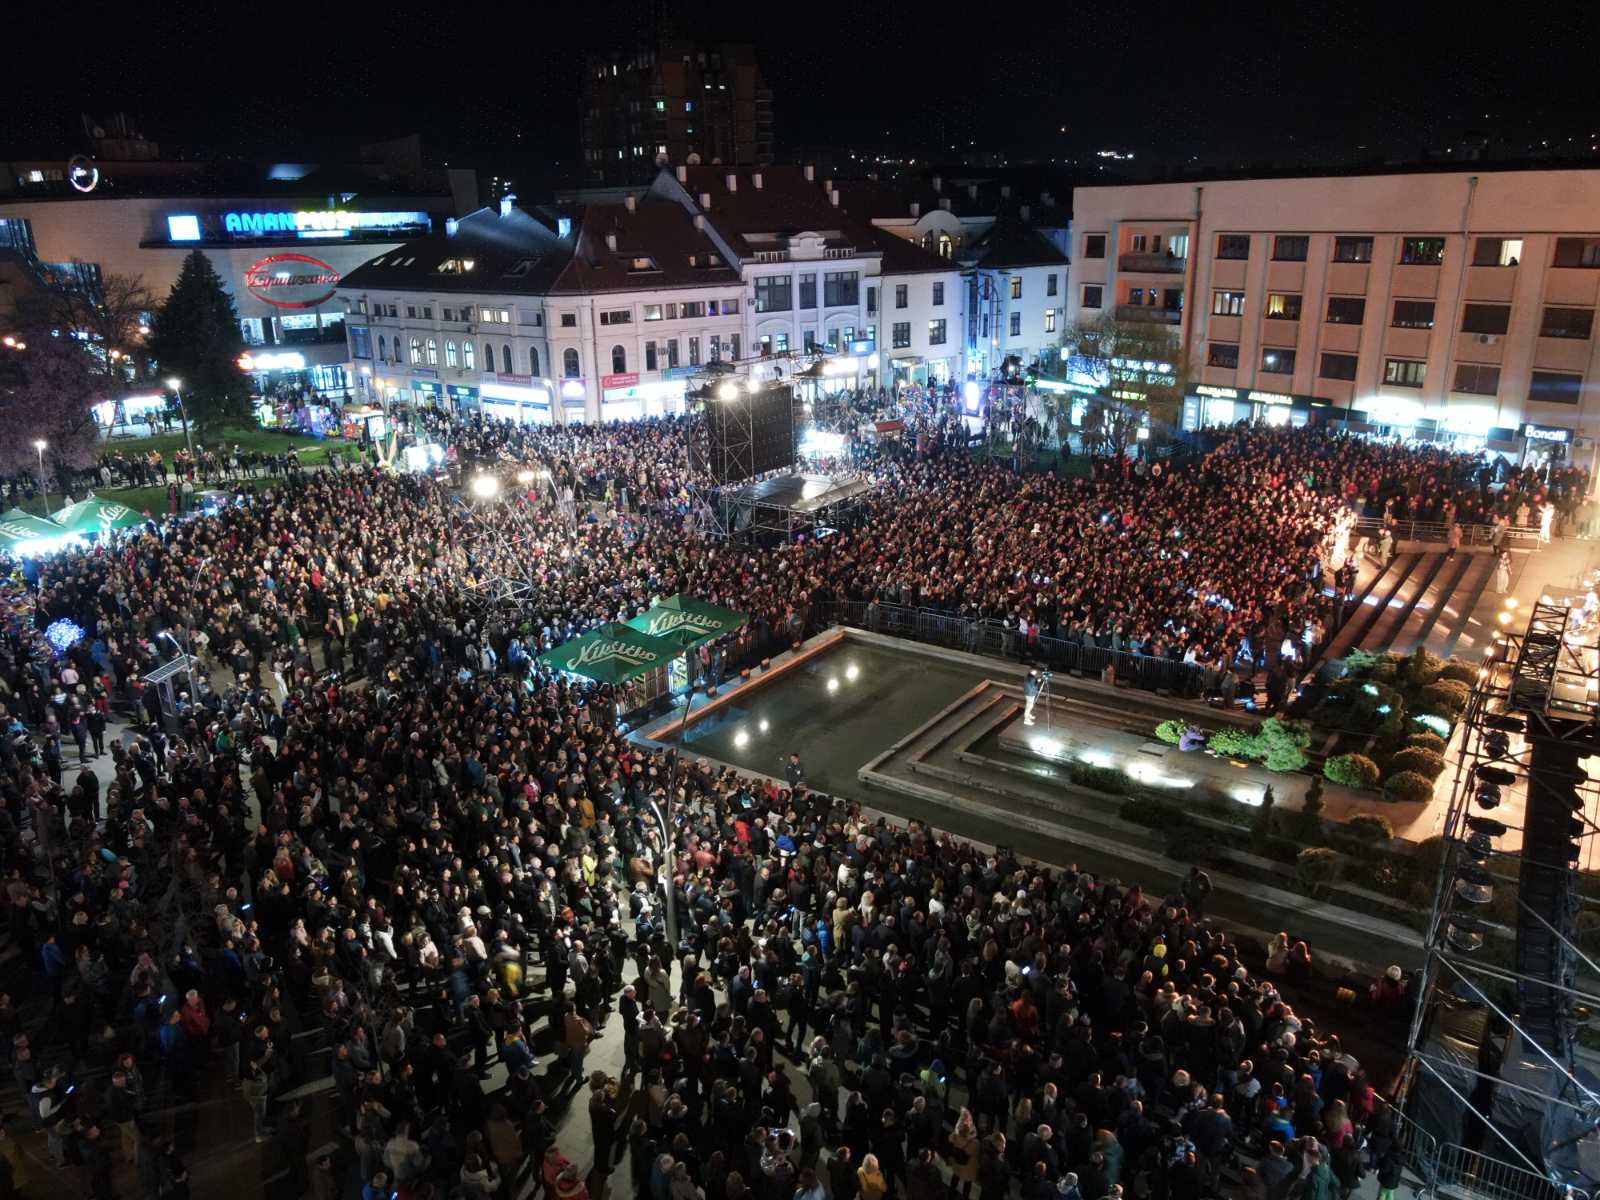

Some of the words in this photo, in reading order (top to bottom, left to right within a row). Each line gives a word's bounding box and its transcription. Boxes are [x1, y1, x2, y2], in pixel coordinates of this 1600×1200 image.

[225, 212, 297, 232] AMAN
[1524, 424, 1567, 442] Bonatti
[566, 639, 657, 671] Nikšićko
